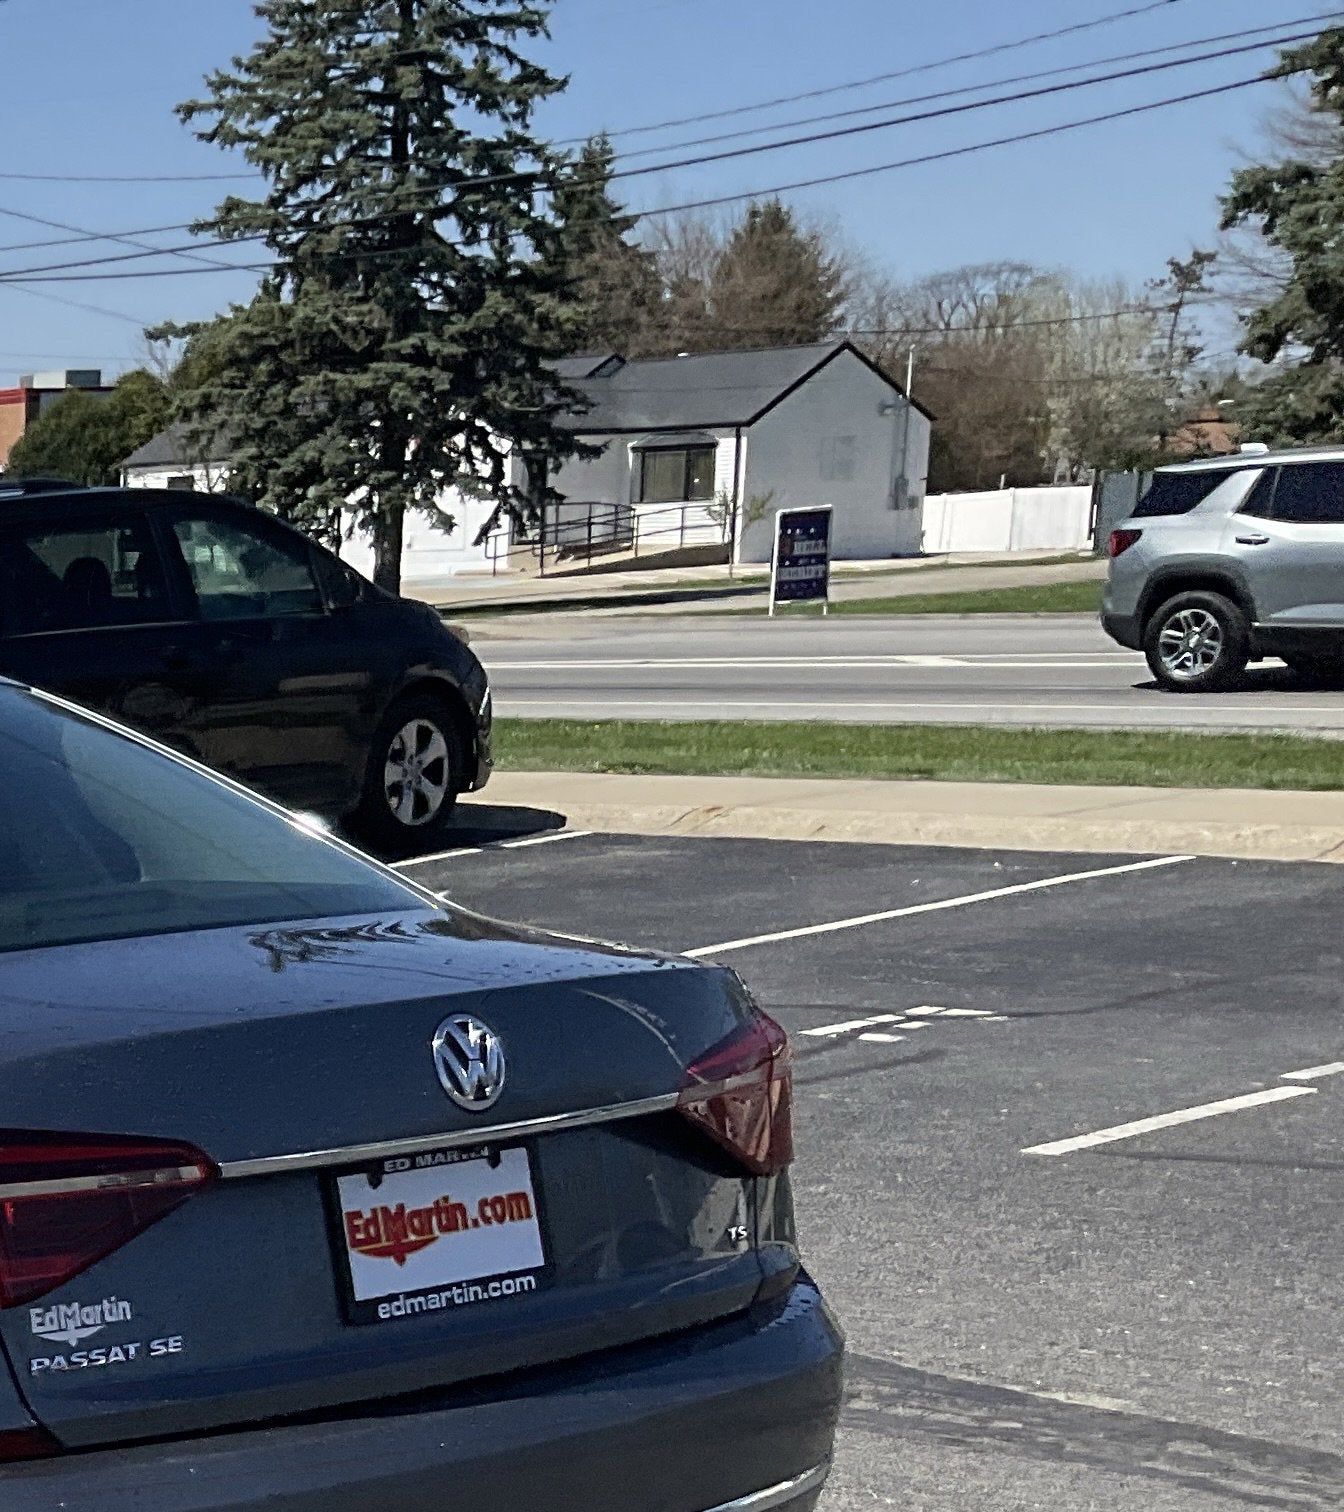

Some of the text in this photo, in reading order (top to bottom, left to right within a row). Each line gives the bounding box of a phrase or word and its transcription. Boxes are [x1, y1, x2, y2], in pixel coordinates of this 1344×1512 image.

[383, 1159, 411, 1173] ED
[344, 1191, 534, 1249] EdMartin.com
[30, 1296, 132, 1333] EdMartin
[377, 1275, 536, 1320] edmartin.com
[30, 1335, 184, 1376] PASSAT SE
